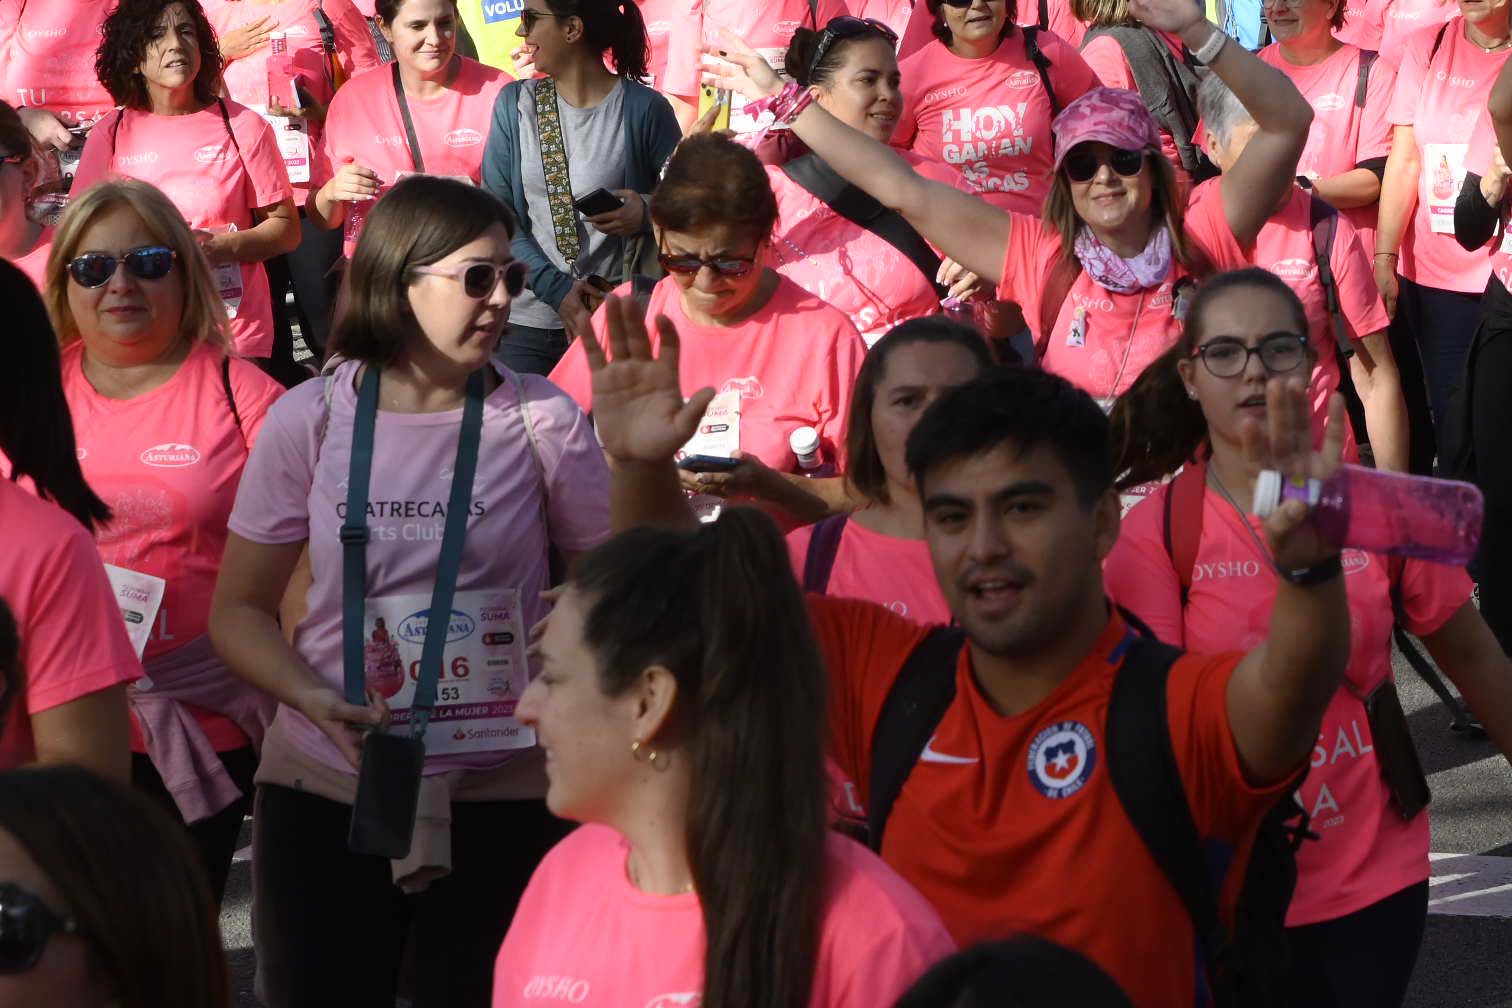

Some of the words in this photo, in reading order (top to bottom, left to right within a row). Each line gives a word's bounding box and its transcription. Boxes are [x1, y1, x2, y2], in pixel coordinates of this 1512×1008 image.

[924, 86, 968, 104] OYSHO
[941, 101, 1029, 143] HOY
[146, 451, 196, 463] ASTURIANA
[1192, 559, 1261, 582] OYSHO
[450, 706, 489, 717] MUJER
[466, 725, 521, 741] Santander
